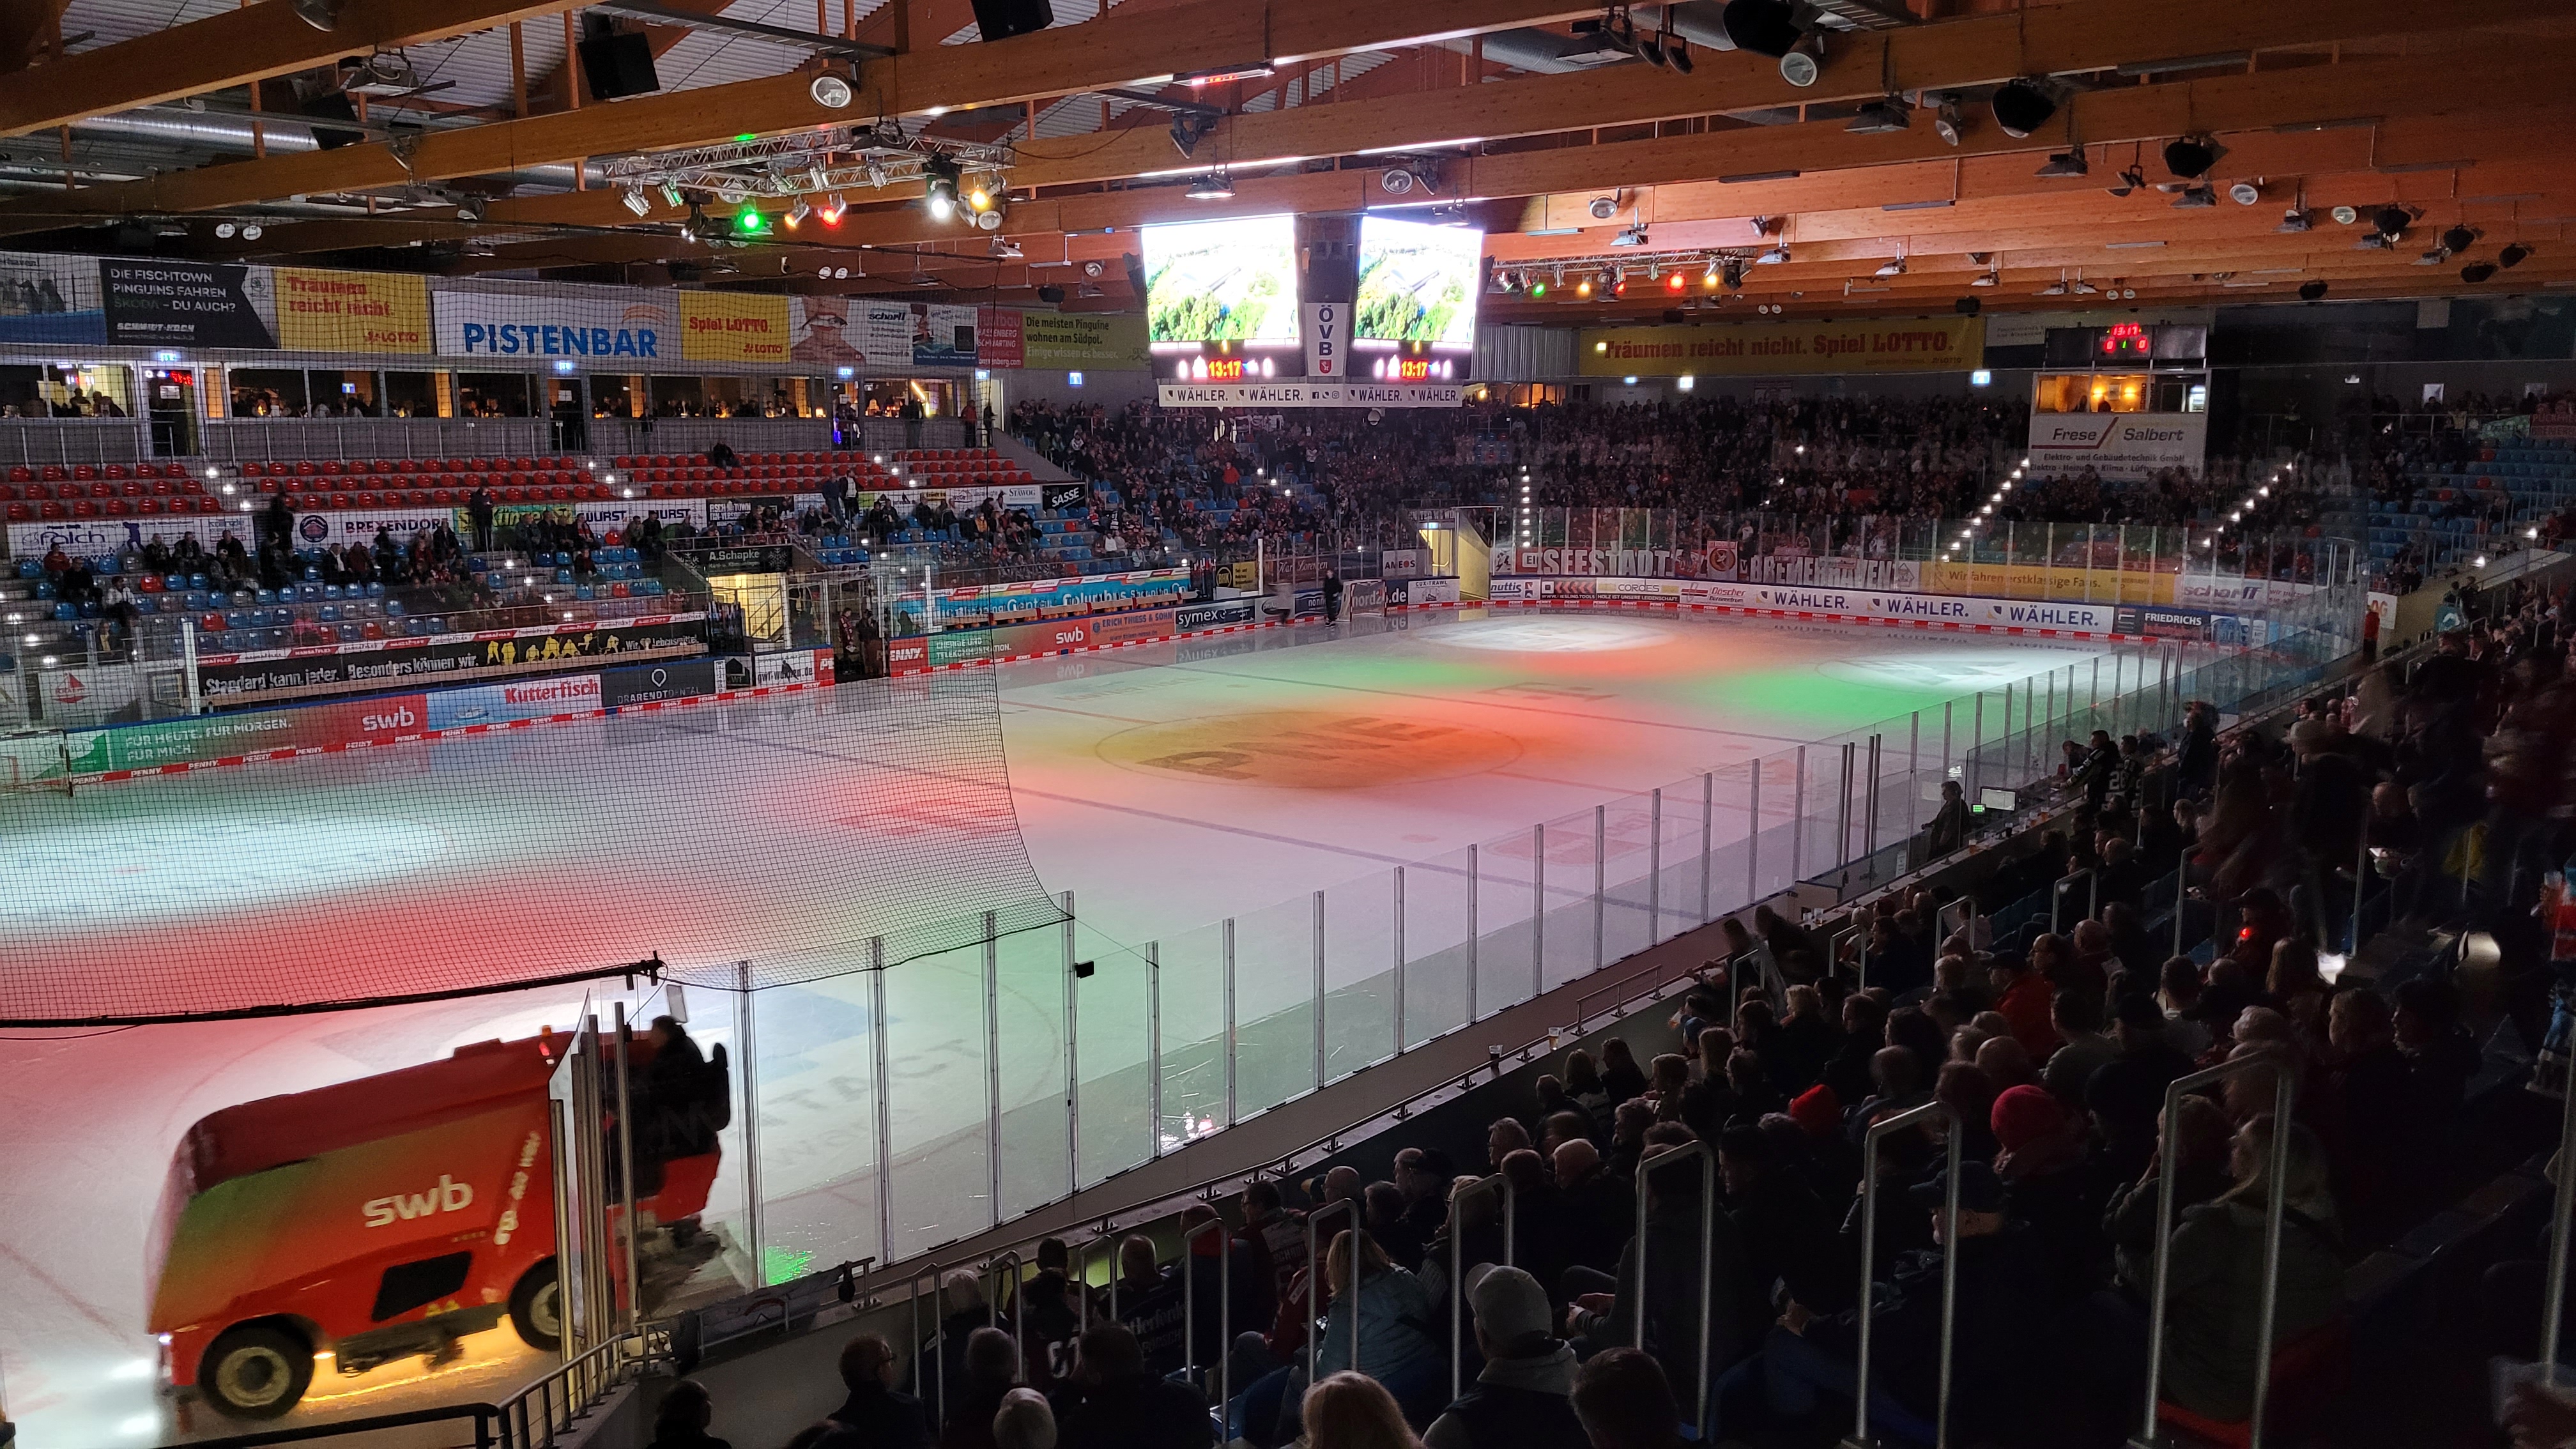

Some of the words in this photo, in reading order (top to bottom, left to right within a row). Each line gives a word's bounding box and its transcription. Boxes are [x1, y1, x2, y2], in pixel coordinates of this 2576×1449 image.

[111, 268, 131, 279] DIE
[135, 270, 212, 282] FISCHTOWN
[112, 283, 174, 296] PINGUINS
[177, 286, 226, 298] FAHREN
[288, 276, 368, 295] Träumen
[172, 300, 190, 310] DU
[194, 301, 236, 313] AUCH?
[289, 298, 341, 314] reicht
[689, 317, 723, 332] Spiel
[726, 318, 772, 334] LOTTO.
[1026, 317, 1039, 328] Die
[1041, 318, 1073, 330] meisten
[1075, 319, 1109, 332] Pinguine
[2113, 325, 2140, 337] 13:17
[463, 323, 657, 358] PISTENBAR
[1026, 332, 1057, 343] wohnen
[1059, 334, 1071, 344] am
[1073, 333, 1103, 347] Südpol.
[1605, 338, 1683, 358] Träumen
[1689, 337, 1744, 356] reicht
[1751, 335, 1807, 356] nicht.
[1814, 334, 1866, 358] Spiel
[1873, 331, 1954, 352] LOTTO.
[2106, 339, 2114, 350] 0
[2121, 340, 2128, 349] 1
[2138, 338, 2147, 349] 0
[755, 343, 783, 355] LOTTO
[1026, 346, 1052, 360] Einige
[1054, 348, 1080, 358] wissen
[1082, 350, 1091, 358] es
[1208, 360, 1242, 378] 13:17
[1401, 360, 1429, 378] 13:17
[1177, 387, 1228, 402] WÄHLER.
[1249, 387, 1303, 402] WÄHLER.
[1358, 387, 1402, 402] WÄHLER.
[1418, 388, 1459, 402] WÄHLER.
[2052, 428, 2097, 441] Frese
[2124, 428, 2184, 441] Salbert
[2093, 454, 2158, 462] Gebäudetechnik
[1052, 487, 1080, 508] SASSE
[709, 549, 760, 562] A.Schapke
[1491, 581, 1522, 592] nuttis
[1949, 571, 1967, 581] Wir
[2008, 573, 2071, 590] rstklasige
[1712, 587, 1746, 597] Döscher
[1774, 589, 1850, 610] WÄHLER.
[2185, 584, 2262, 600] scharff
[1887, 597, 1970, 617] WÄHLER.
[1102, 617, 1123, 628] ERICH
[1124, 614, 1147, 625] THIESS
[1154, 611, 1173, 622] SOHN
[1177, 610, 1218, 628] symex
[2009, 604, 2099, 627] WÄHLER.
[2144, 612, 2203, 626] FRIEDRICHS
[936, 639, 966, 650] ENERGIE
[967, 637, 983, 646] UND
[1055, 626, 1085, 645] swb
[625, 639, 640, 651] Wir
[204, 672, 267, 695] Standard
[347, 661, 413, 680] Besonders
[412, 655, 456, 674] können
[458, 653, 480, 670] wir.
[504, 678, 599, 705] Kutterfisch
[362, 705, 415, 732] swb
[125, 734, 151, 748] FÜR
[155, 729, 203, 744] HEUTE.
[206, 725, 231, 738] FÜR
[234, 717, 293, 734] MORGEN.
[127, 748, 153, 762] FÜR
[157, 744, 196, 758] MICH.
[362, 1174, 474, 1229] swb
